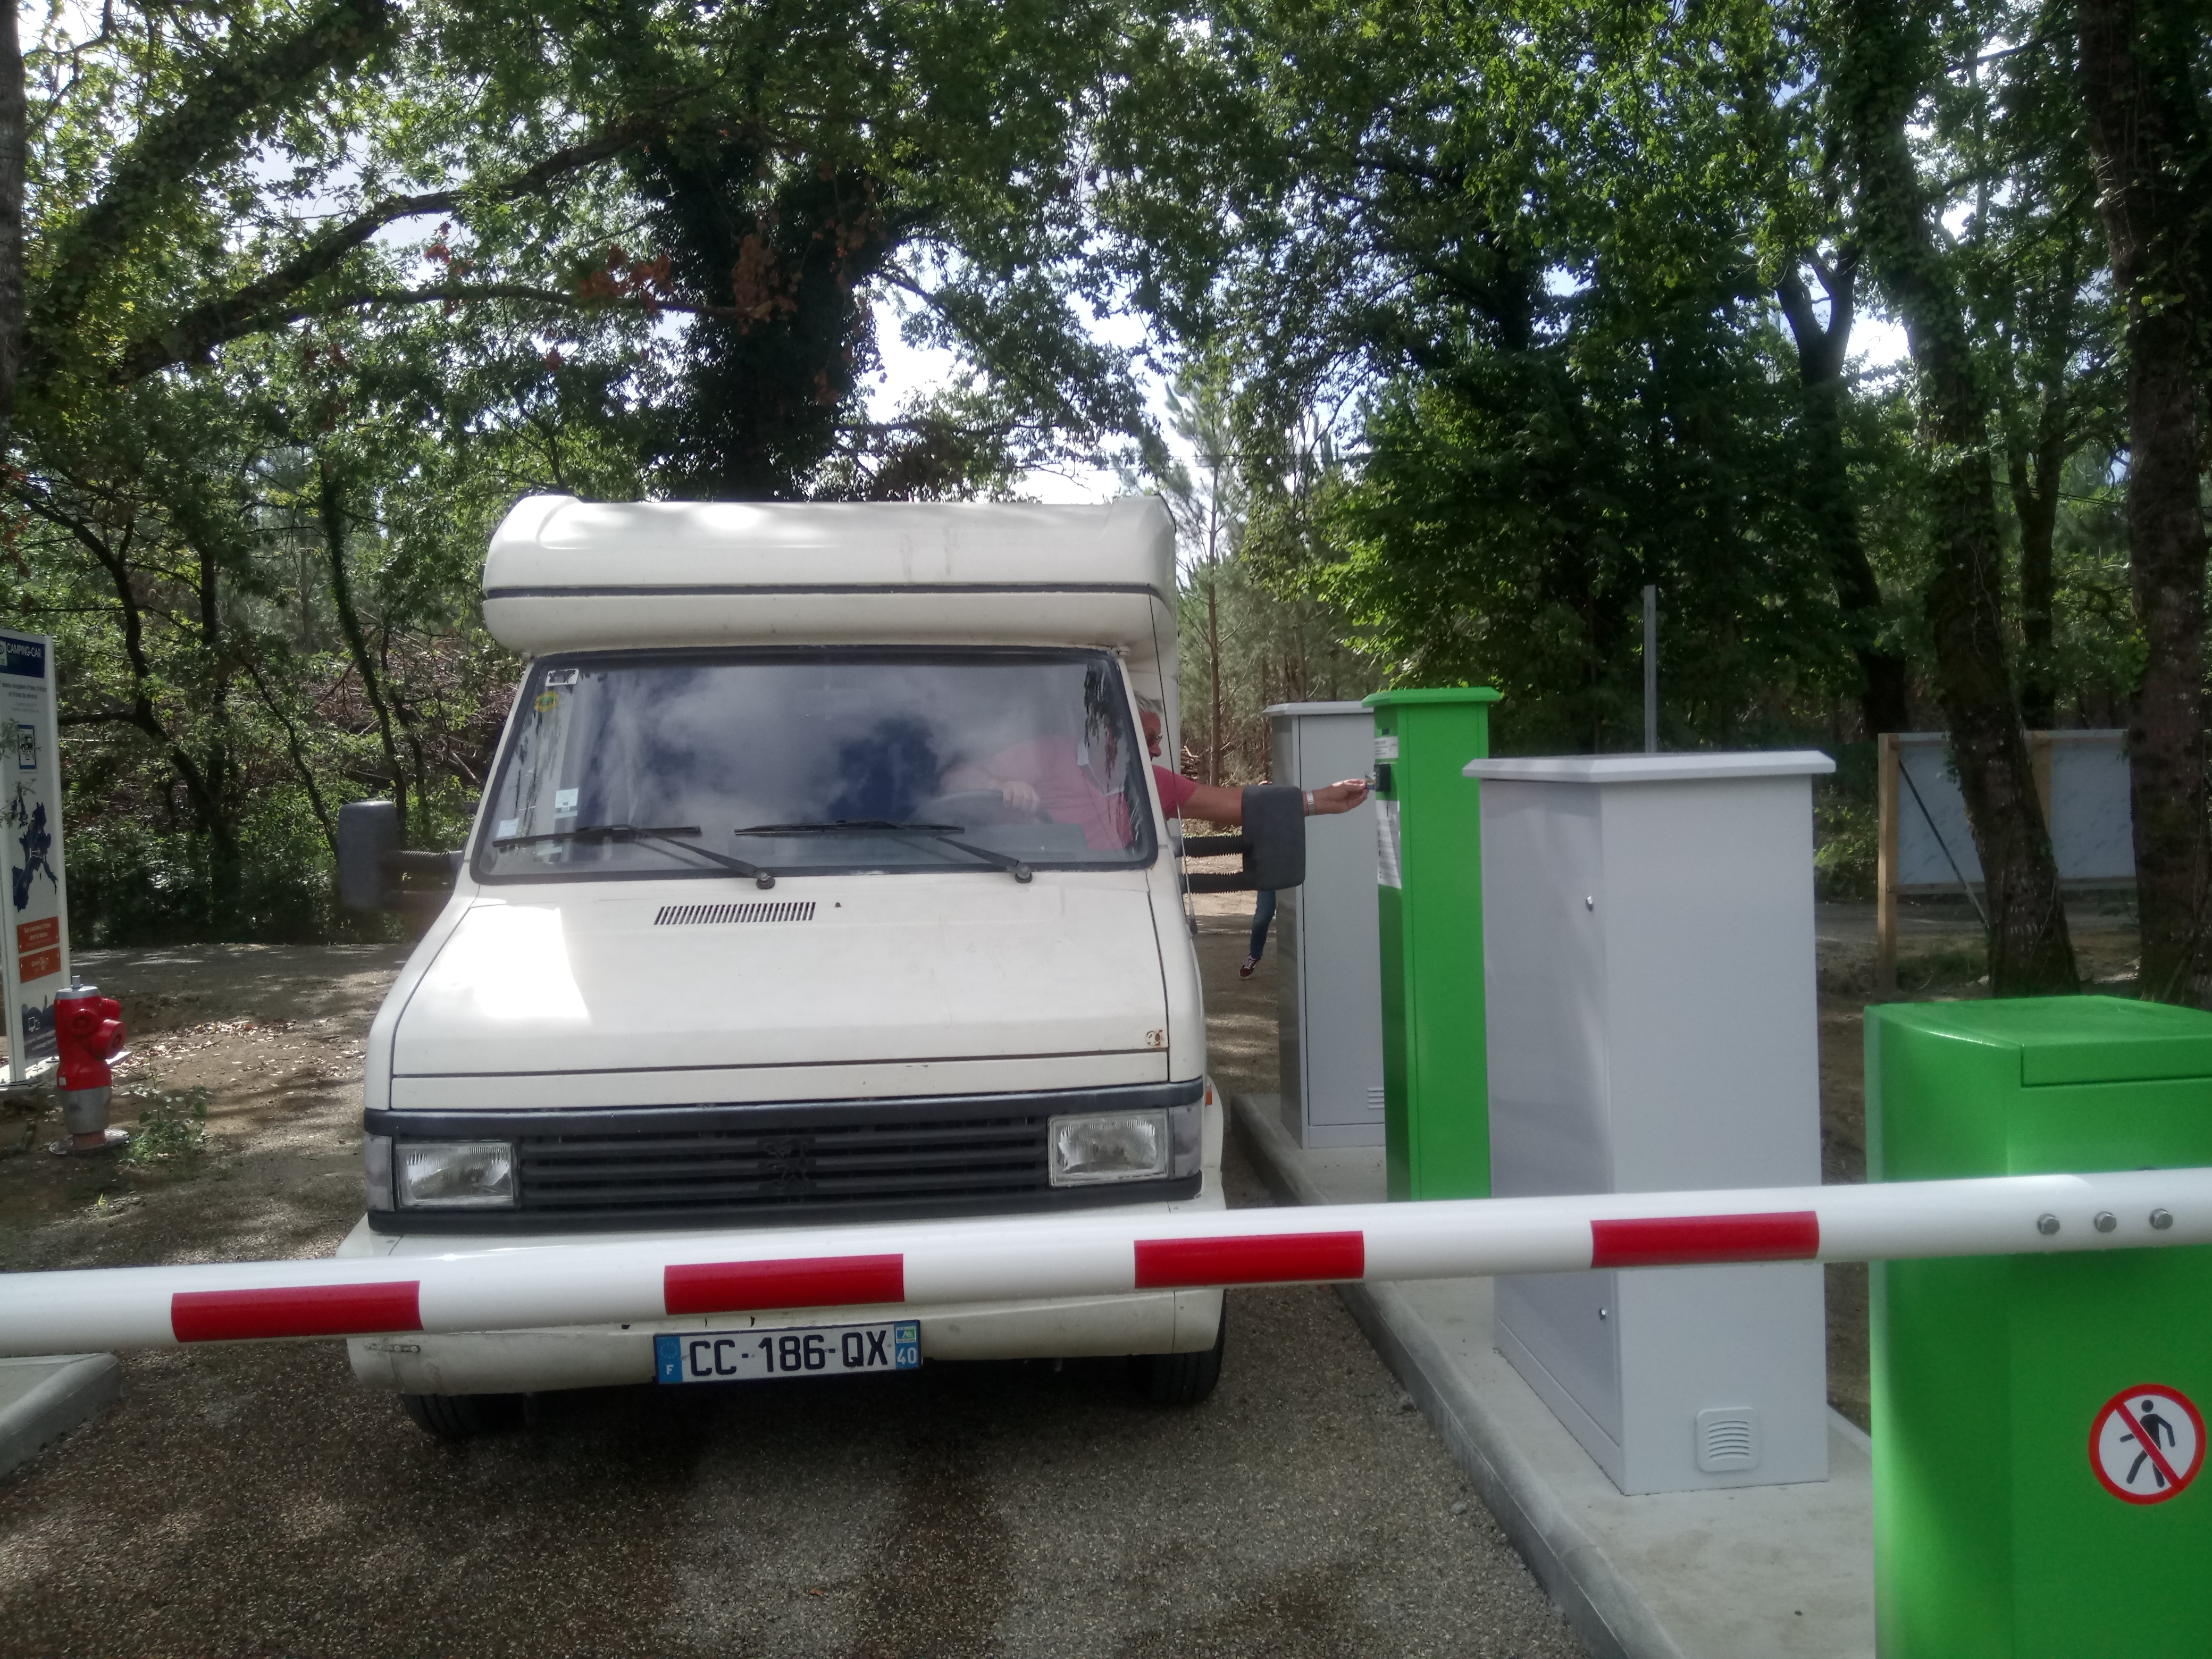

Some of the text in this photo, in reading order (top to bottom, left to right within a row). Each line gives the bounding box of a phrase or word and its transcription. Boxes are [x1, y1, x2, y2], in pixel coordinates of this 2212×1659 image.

[7, 643, 41, 657] CAMPING-CAR
[666, 1330, 918, 1376] F CC-186-QX 40
